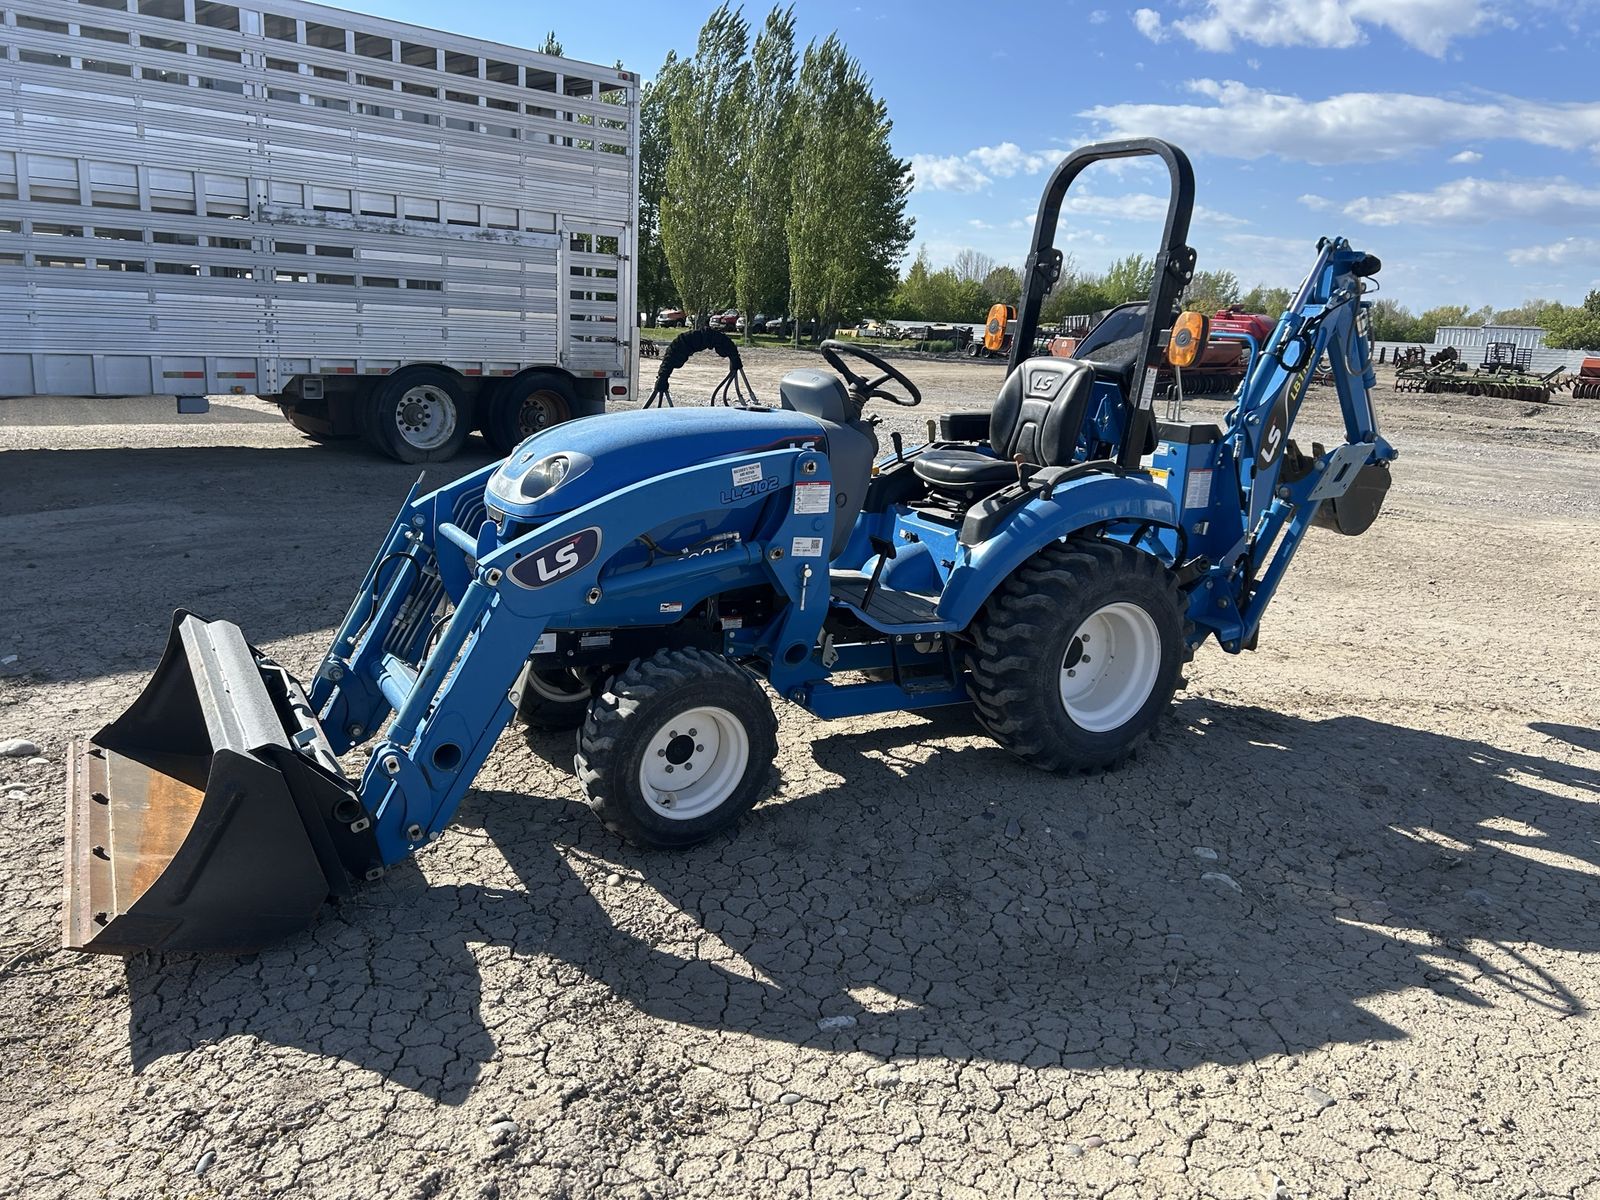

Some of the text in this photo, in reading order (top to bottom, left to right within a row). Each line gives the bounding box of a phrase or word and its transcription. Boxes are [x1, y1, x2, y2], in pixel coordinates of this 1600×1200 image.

[1034, 375, 1054, 391] LS
[1260, 425, 1281, 463] LS
[720, 476, 780, 504] LL2102
[536, 543, 579, 582] LS
